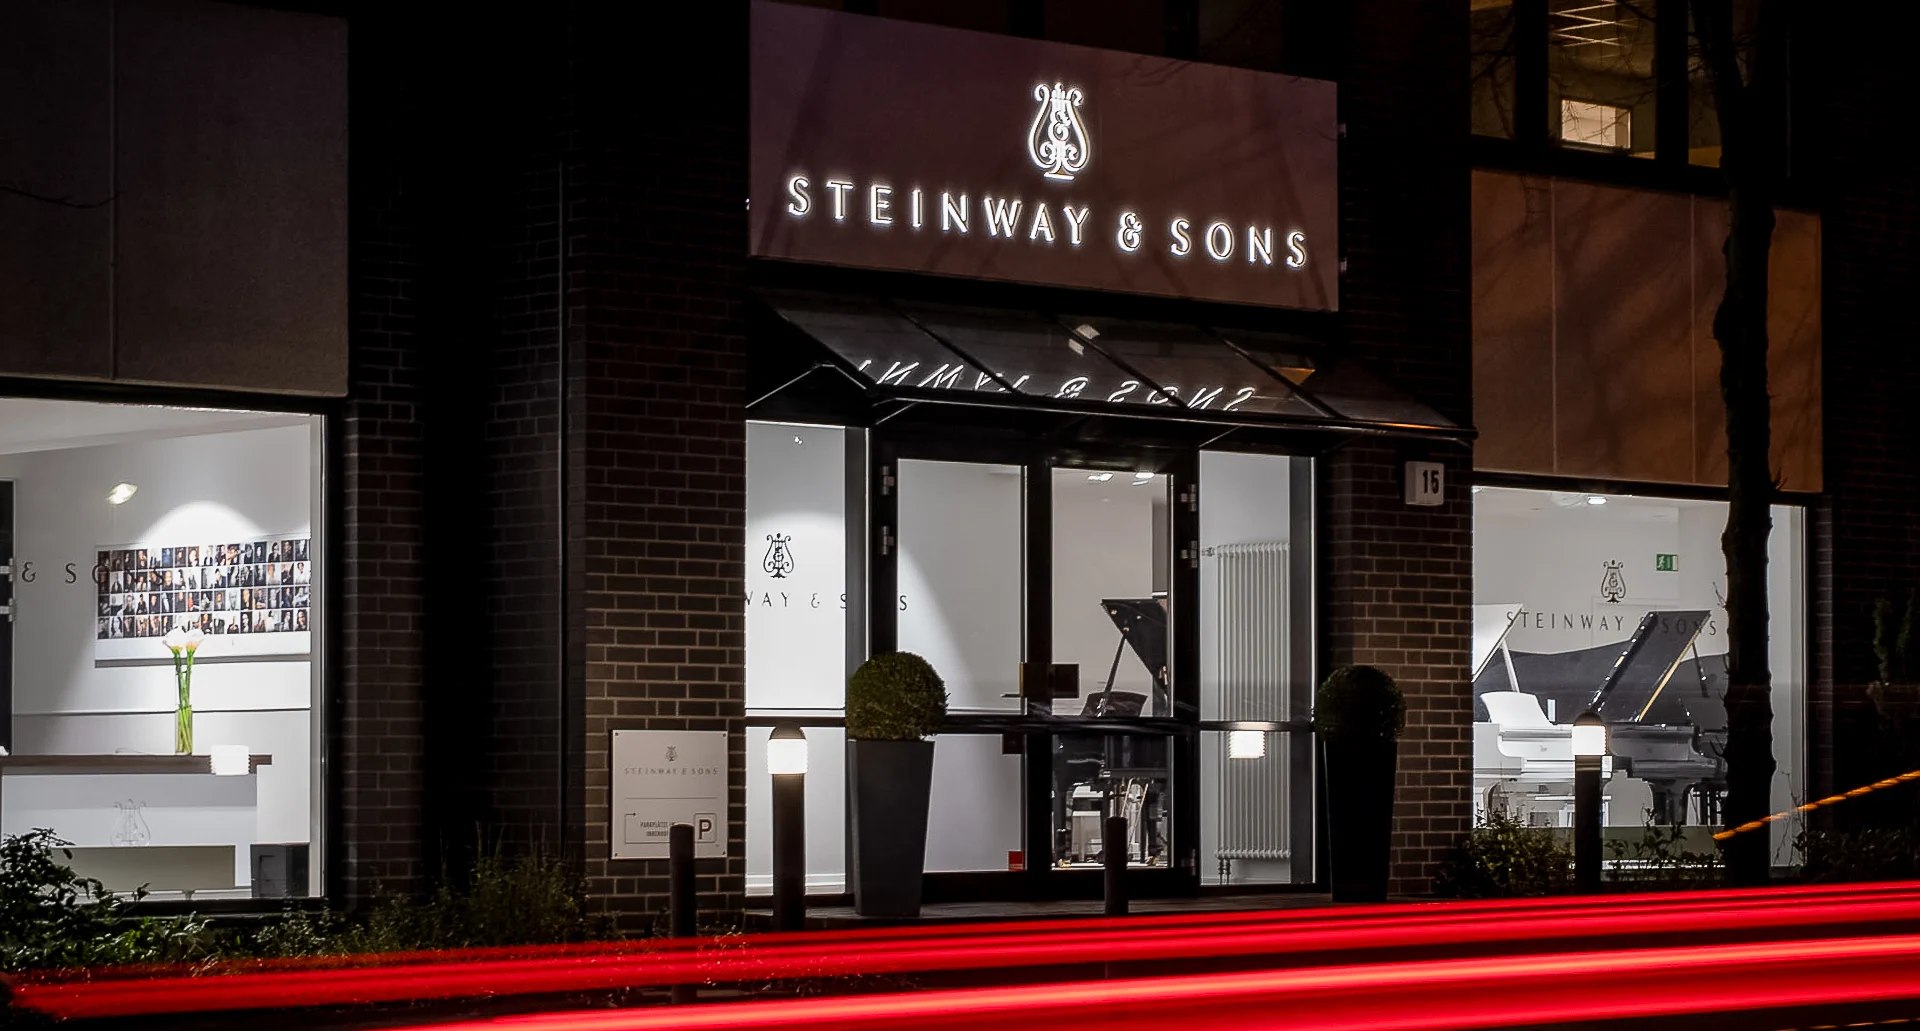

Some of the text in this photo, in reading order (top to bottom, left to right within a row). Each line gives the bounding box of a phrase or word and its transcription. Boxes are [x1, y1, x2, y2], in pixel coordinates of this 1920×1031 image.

[787, 174, 1307, 269] STEINWAY & SONS
[1422, 469, 1440, 495] 15
[21, 561, 37, 583] &
[1506, 611, 1625, 632] STEINWAY
[691, 767, 718, 775] SONS
[698, 818, 712, 840] P
